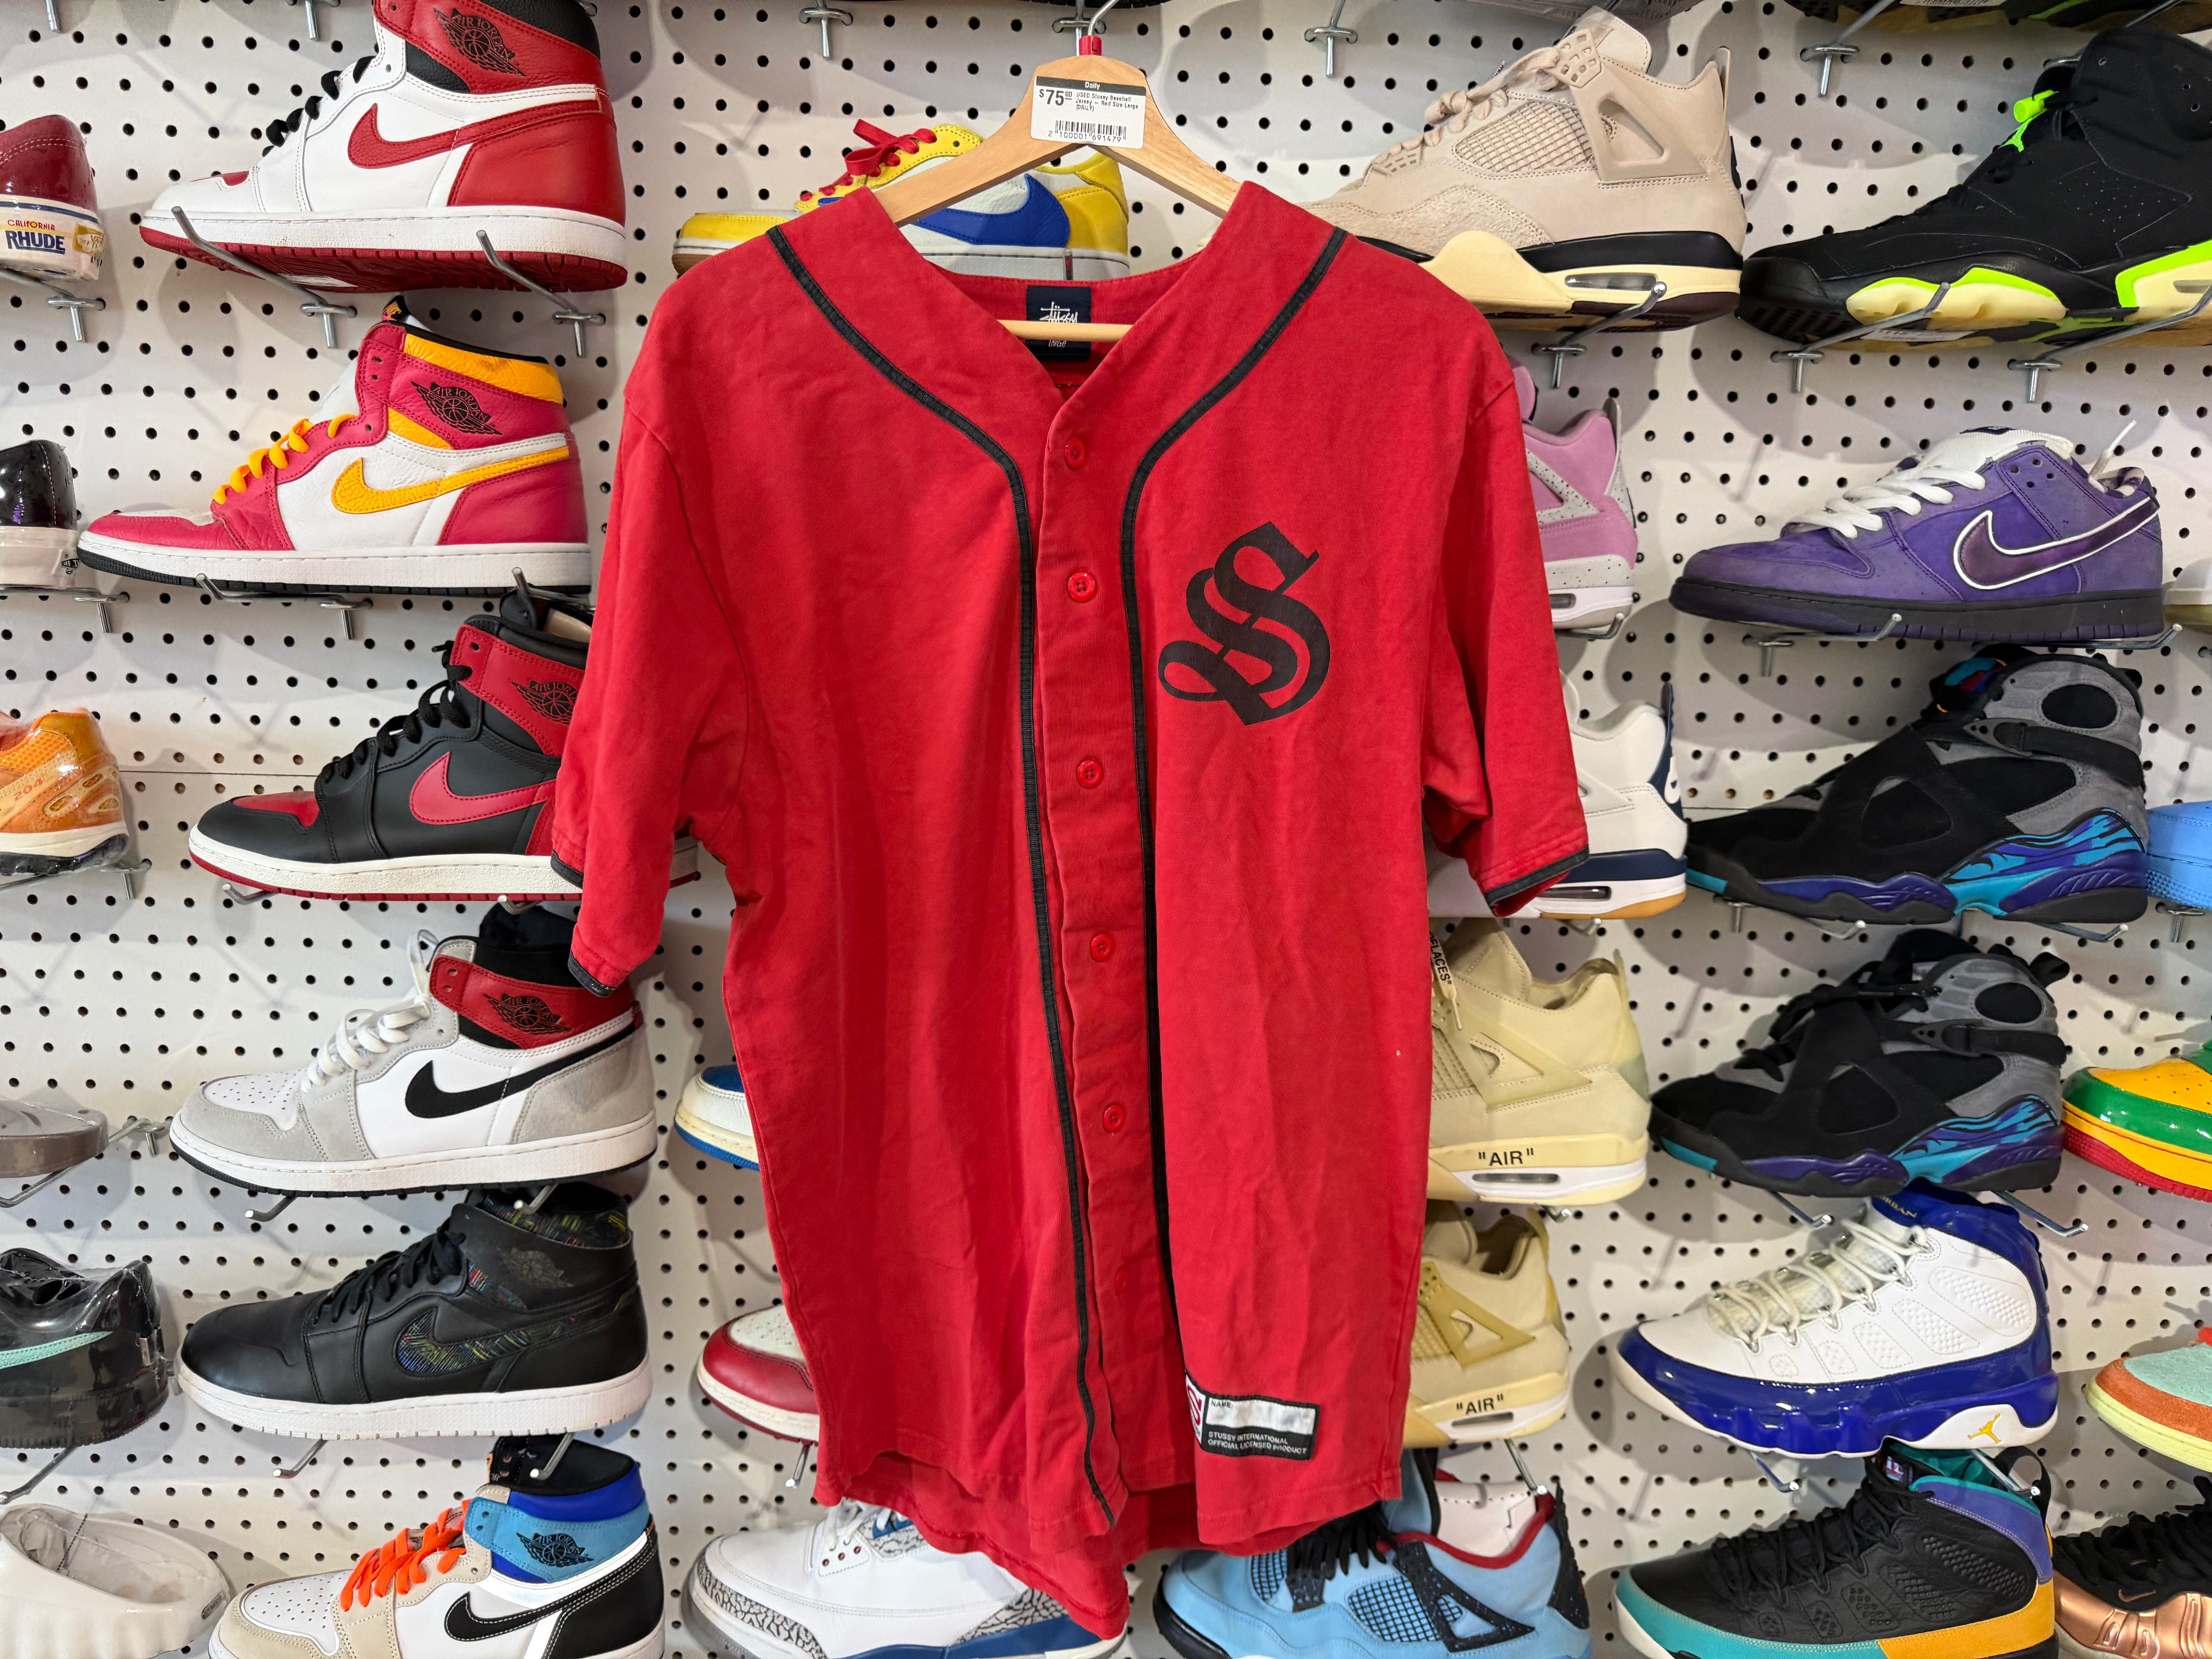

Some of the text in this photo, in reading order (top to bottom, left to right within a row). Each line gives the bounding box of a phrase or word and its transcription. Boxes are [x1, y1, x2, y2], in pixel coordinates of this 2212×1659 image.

[451, 15, 512, 62] AIR JORDAN
[1092, 41, 1098, 52] L
[1085, 81, 1101, 90] Daily
[1076, 104, 1094, 112] (DAILY)
[7, 220, 55, 231] CALIFORNIA
[5, 230, 65, 254] RHUDE
[433, 387, 488, 424] AIR JORDAN
[1158, 521, 1331, 726] S
[532, 682, 578, 700] AIR JORD
[504, 996, 556, 1023] AIR JORDAN
[1478, 1147, 1534, 1166] "AIR"
[1211, 1400, 1234, 1408] NAME:
[1456, 1393, 1504, 1415] "AIR"
[1208, 1431, 1289, 1445] STUSSY INTERNATIONAL
[1208, 1439, 1308, 1455] OFFICIAL LICENSED PRODUCT
[555, 1534, 580, 1555] JORDAN
